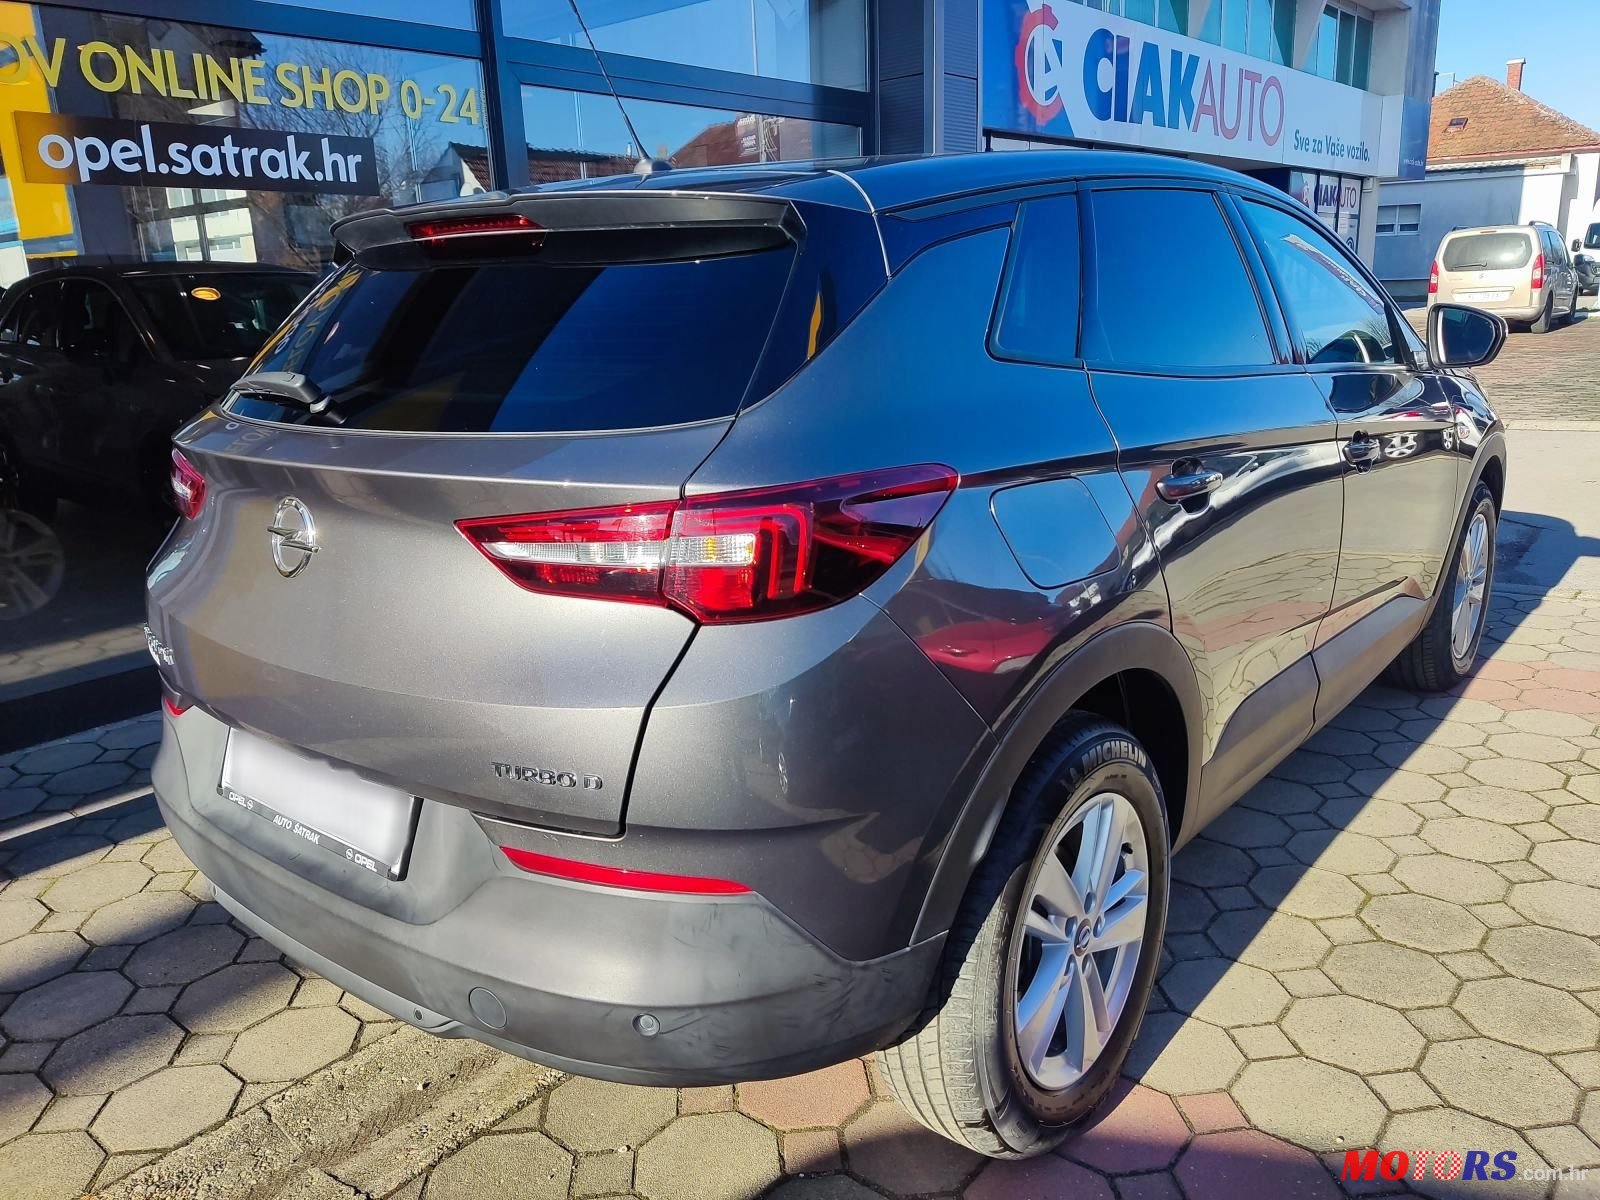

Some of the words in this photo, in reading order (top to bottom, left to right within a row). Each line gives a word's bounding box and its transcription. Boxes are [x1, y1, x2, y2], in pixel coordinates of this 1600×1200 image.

[79, 41, 271, 105] ONLINE
[275, 62, 391, 115] SHOP
[401, 79, 479, 125] 0-24
[38, 124, 362, 183] opel.satrak.hr
[1293, 129, 1310, 152] Sve
[1312, 139, 1322, 154] za
[1325, 135, 1345, 158] Vaše
[1081, 740, 1148, 774] MICHELIN
[490, 761, 577, 788] TURBO
[583, 773, 603, 790] D
[228, 791, 247, 808] OPEL
[272, 814, 292, 829] AUTO
[354, 853, 378, 873] OPEL
